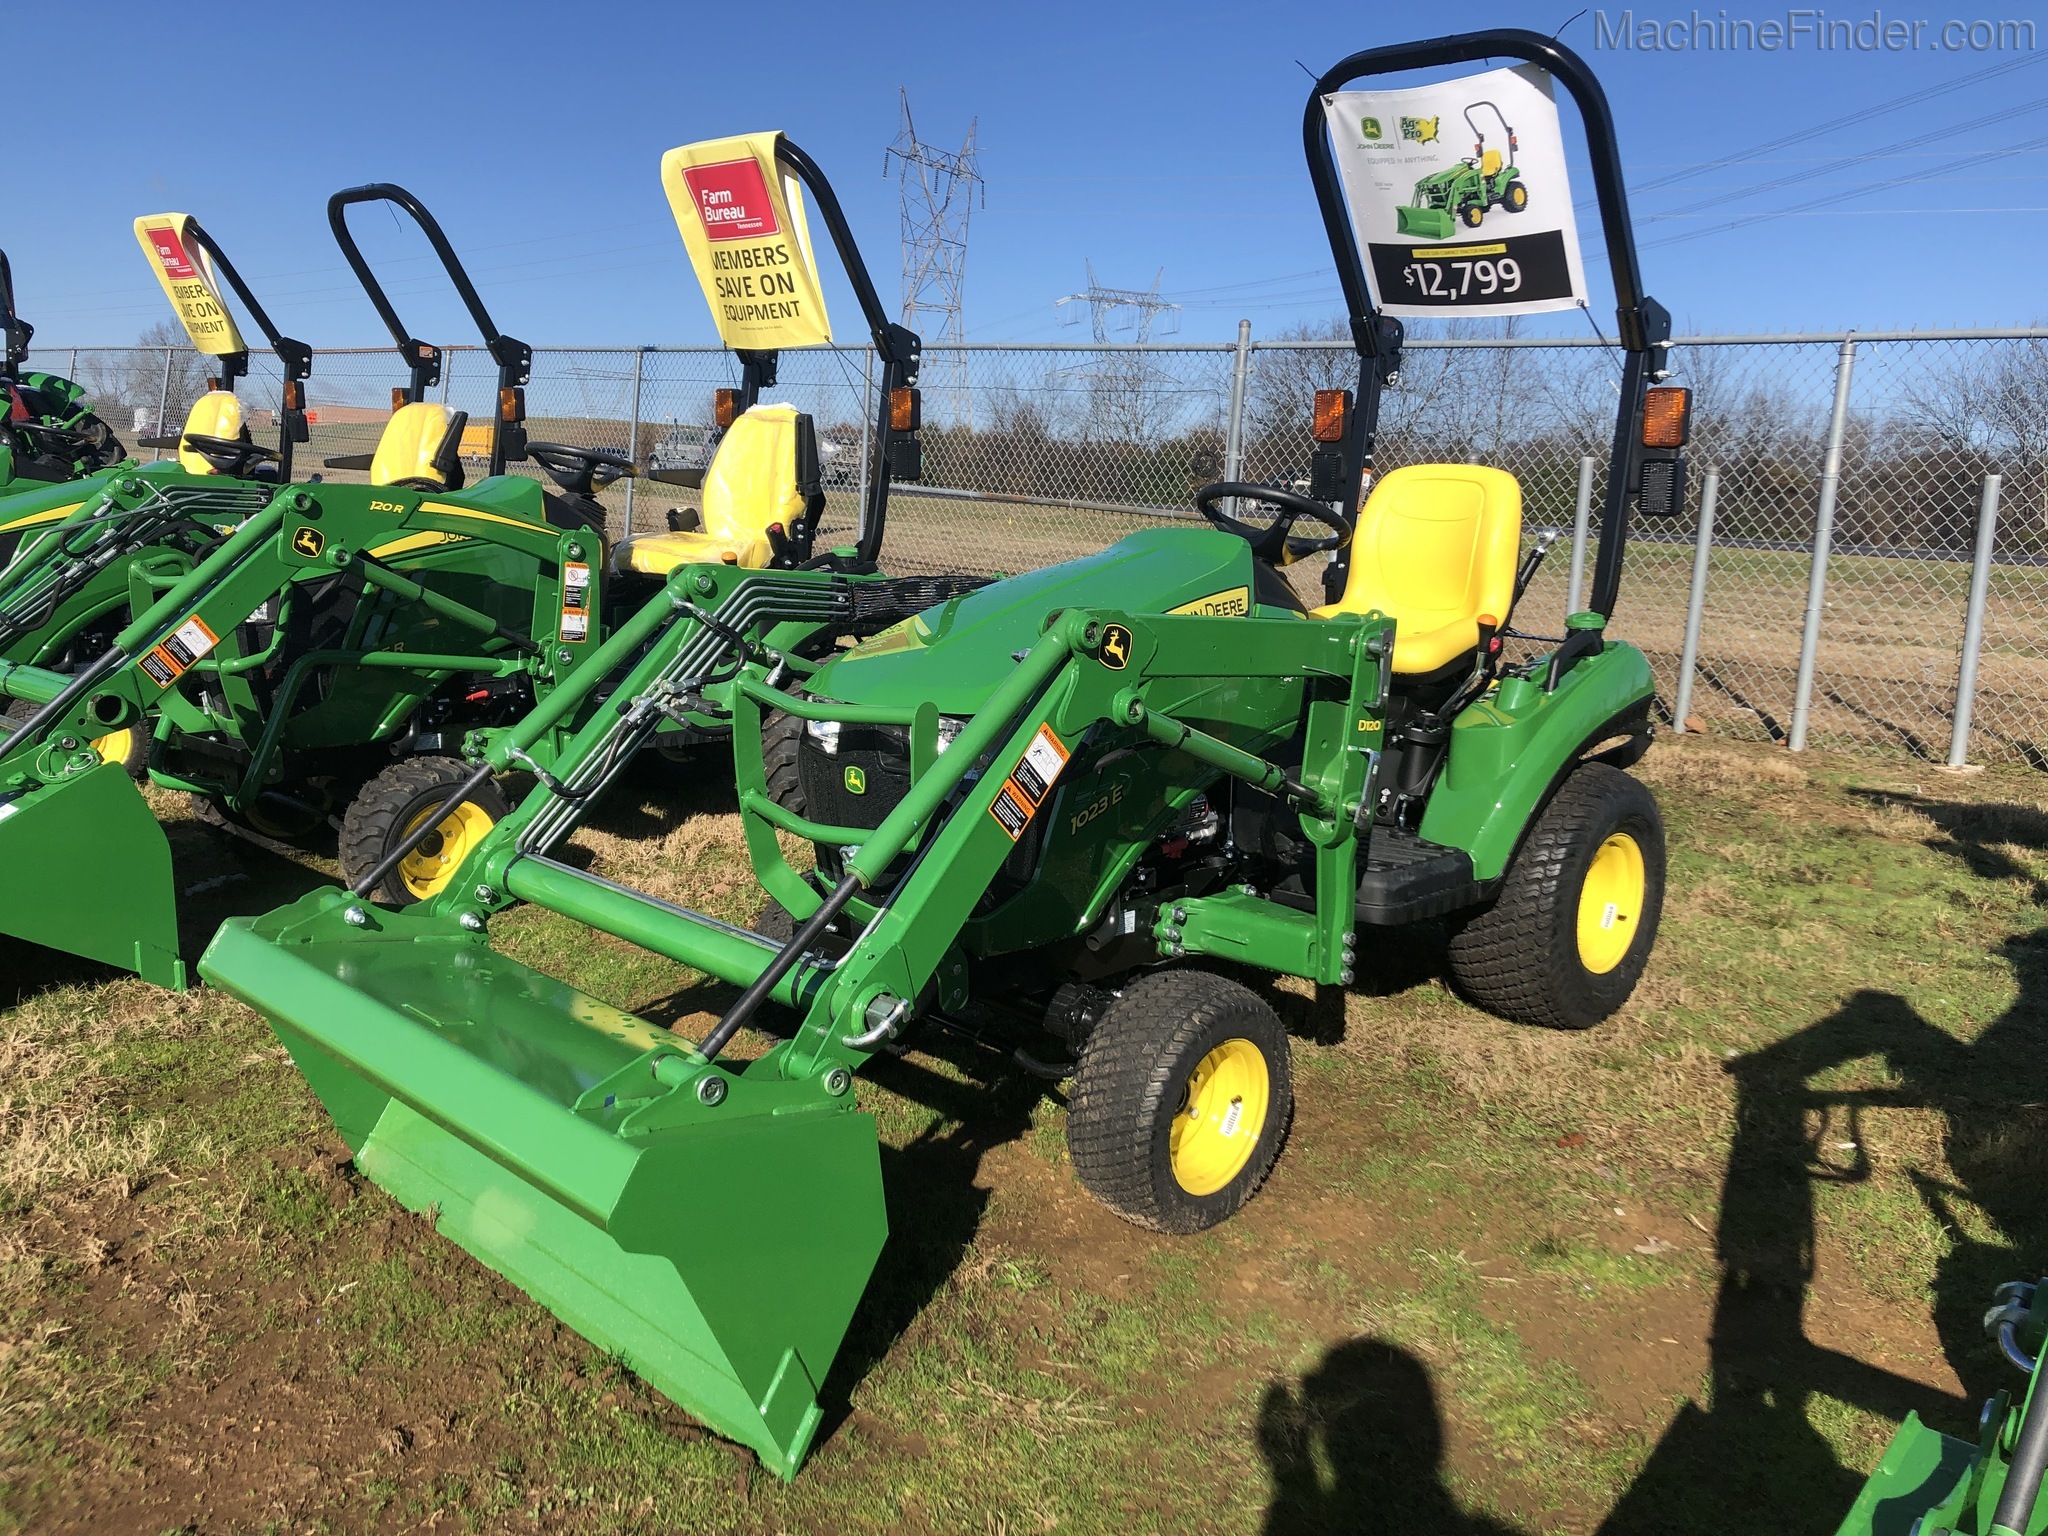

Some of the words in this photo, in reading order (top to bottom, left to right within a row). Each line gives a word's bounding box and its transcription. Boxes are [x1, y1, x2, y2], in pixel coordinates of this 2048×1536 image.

[1403, 129, 1422, 139] Pro
[701, 189, 732, 205] Farm
[704, 206, 745, 222] Bureau
[736, 221, 763, 230] Tennessee
[715, 276, 756, 298] SAVE
[760, 271, 795, 296] ON
[1403, 258, 1522, 300] $12,799
[196, 301, 220, 318] ON
[723, 300, 800, 322] EQUIPMENT
[369, 500, 393, 512] 120
[393, 504, 404, 514] R
[1205, 598, 1244, 617] DEERE
[1358, 719, 1381, 731] D120
[1046, 734, 1066, 757] WARNING
[1070, 796, 1109, 836] 1023
[1112, 784, 1123, 805] E
